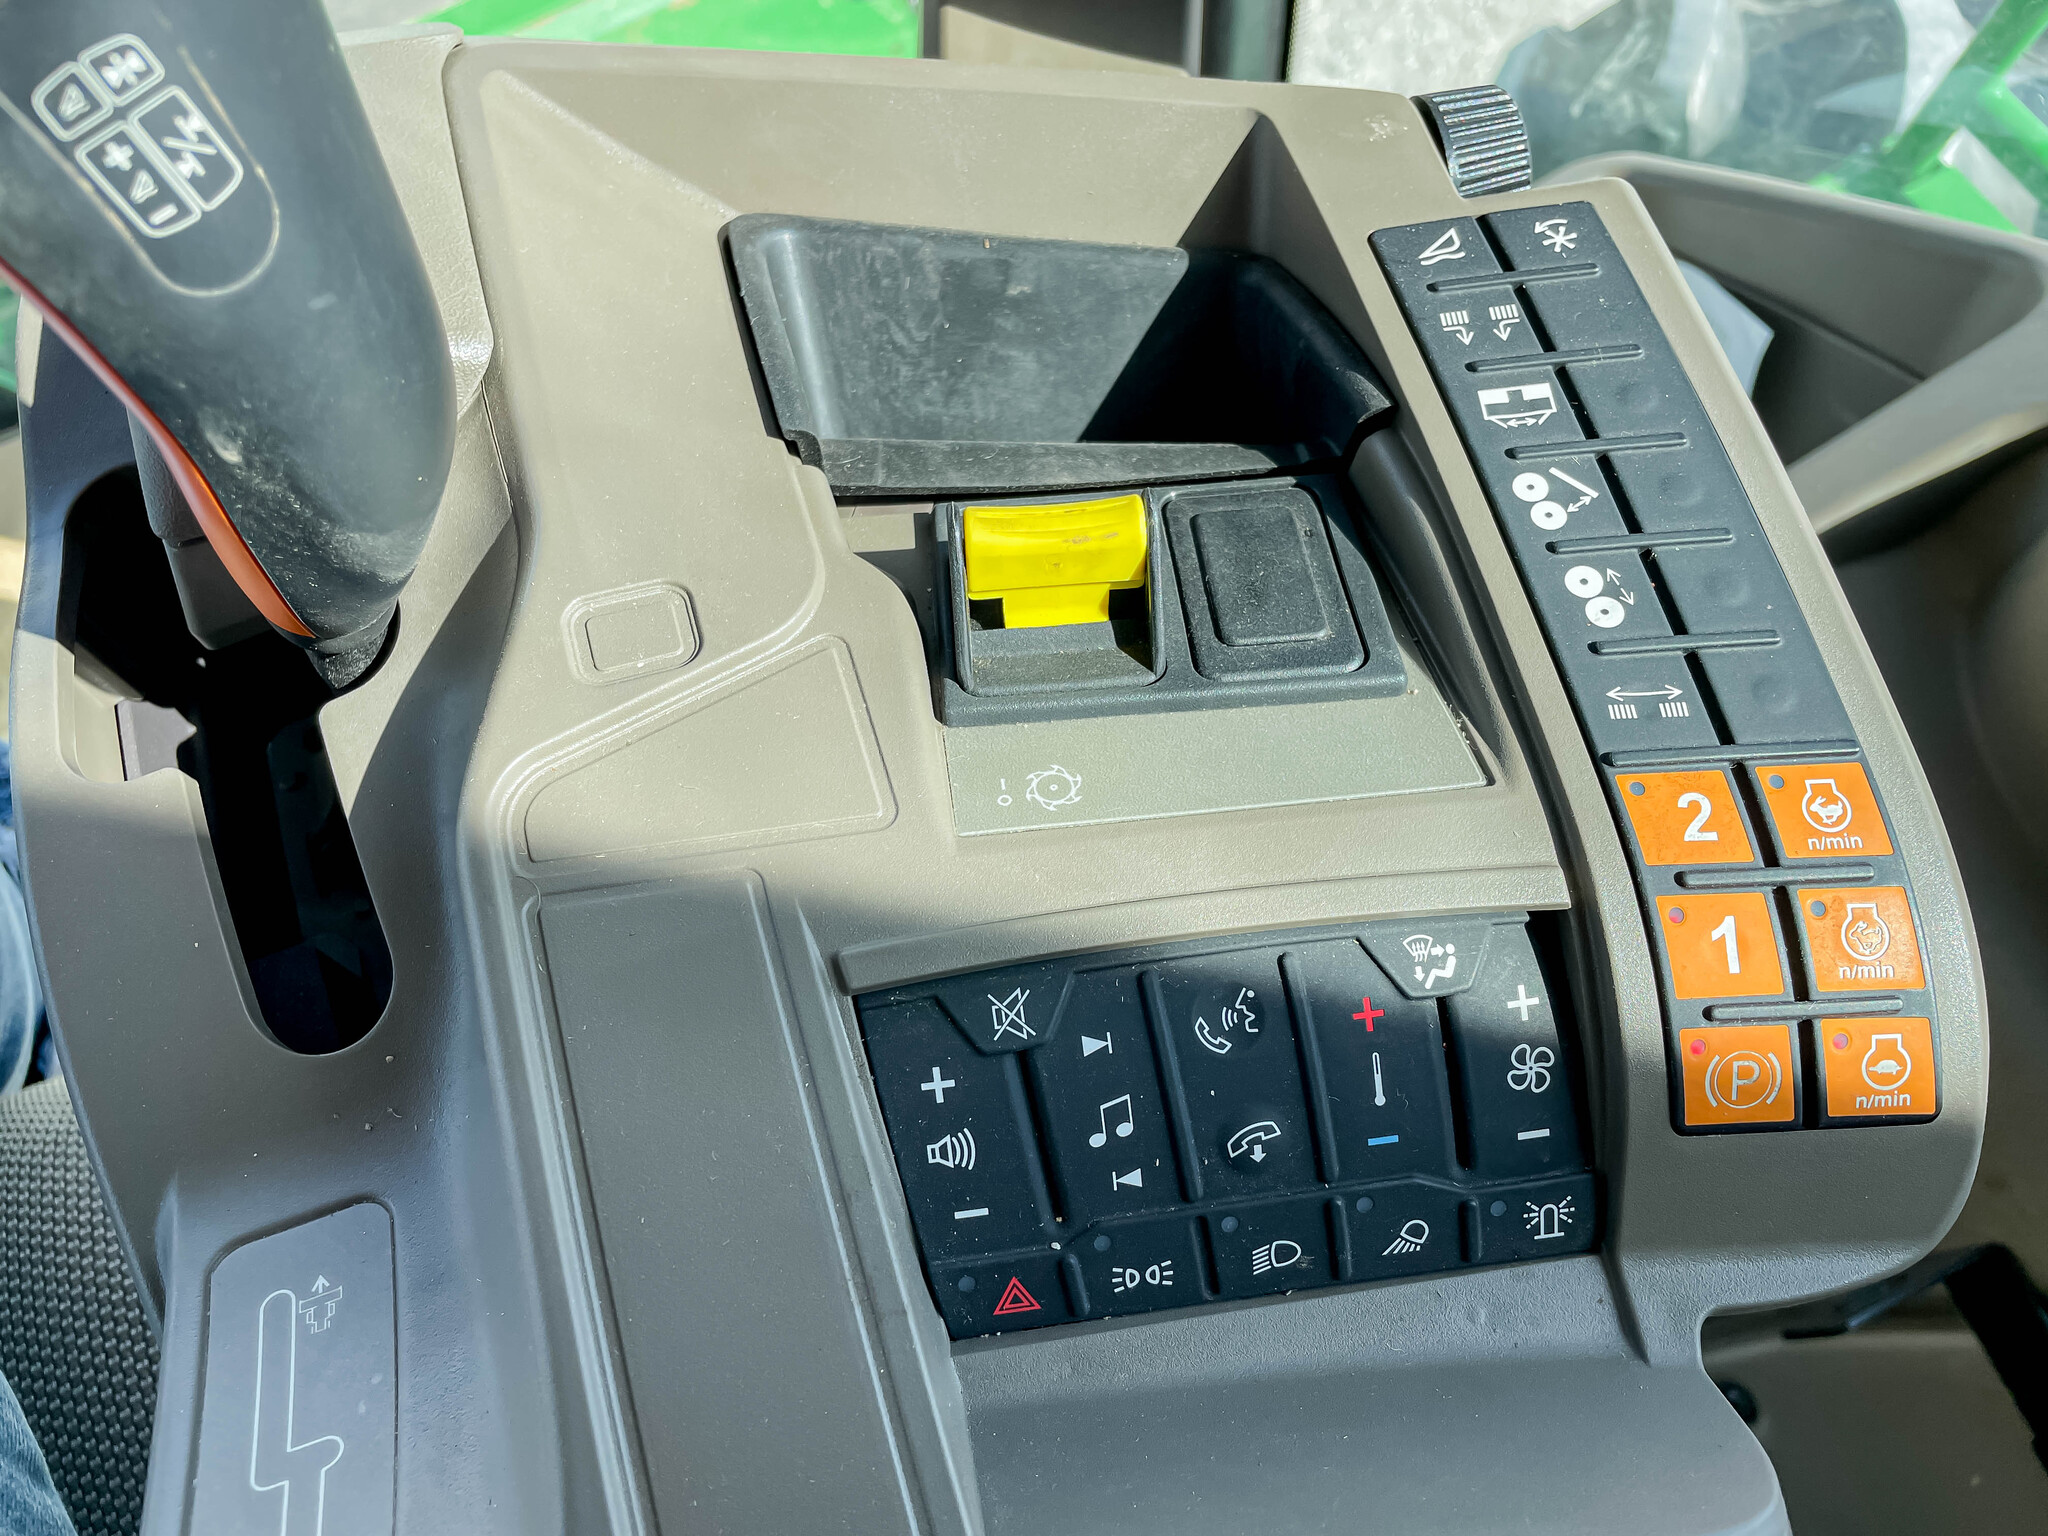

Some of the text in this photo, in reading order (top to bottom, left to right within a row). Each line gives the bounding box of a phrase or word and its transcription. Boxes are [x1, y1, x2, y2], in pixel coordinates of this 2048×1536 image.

[1677, 792, 1719, 842] 2
[1807, 832, 1863, 851] n/min
[1711, 915, 1740, 974] 1
[1839, 961, 1894, 980] n/min
[1731, 1060, 1761, 1101] P
[1855, 1090, 1911, 1109] n/min
